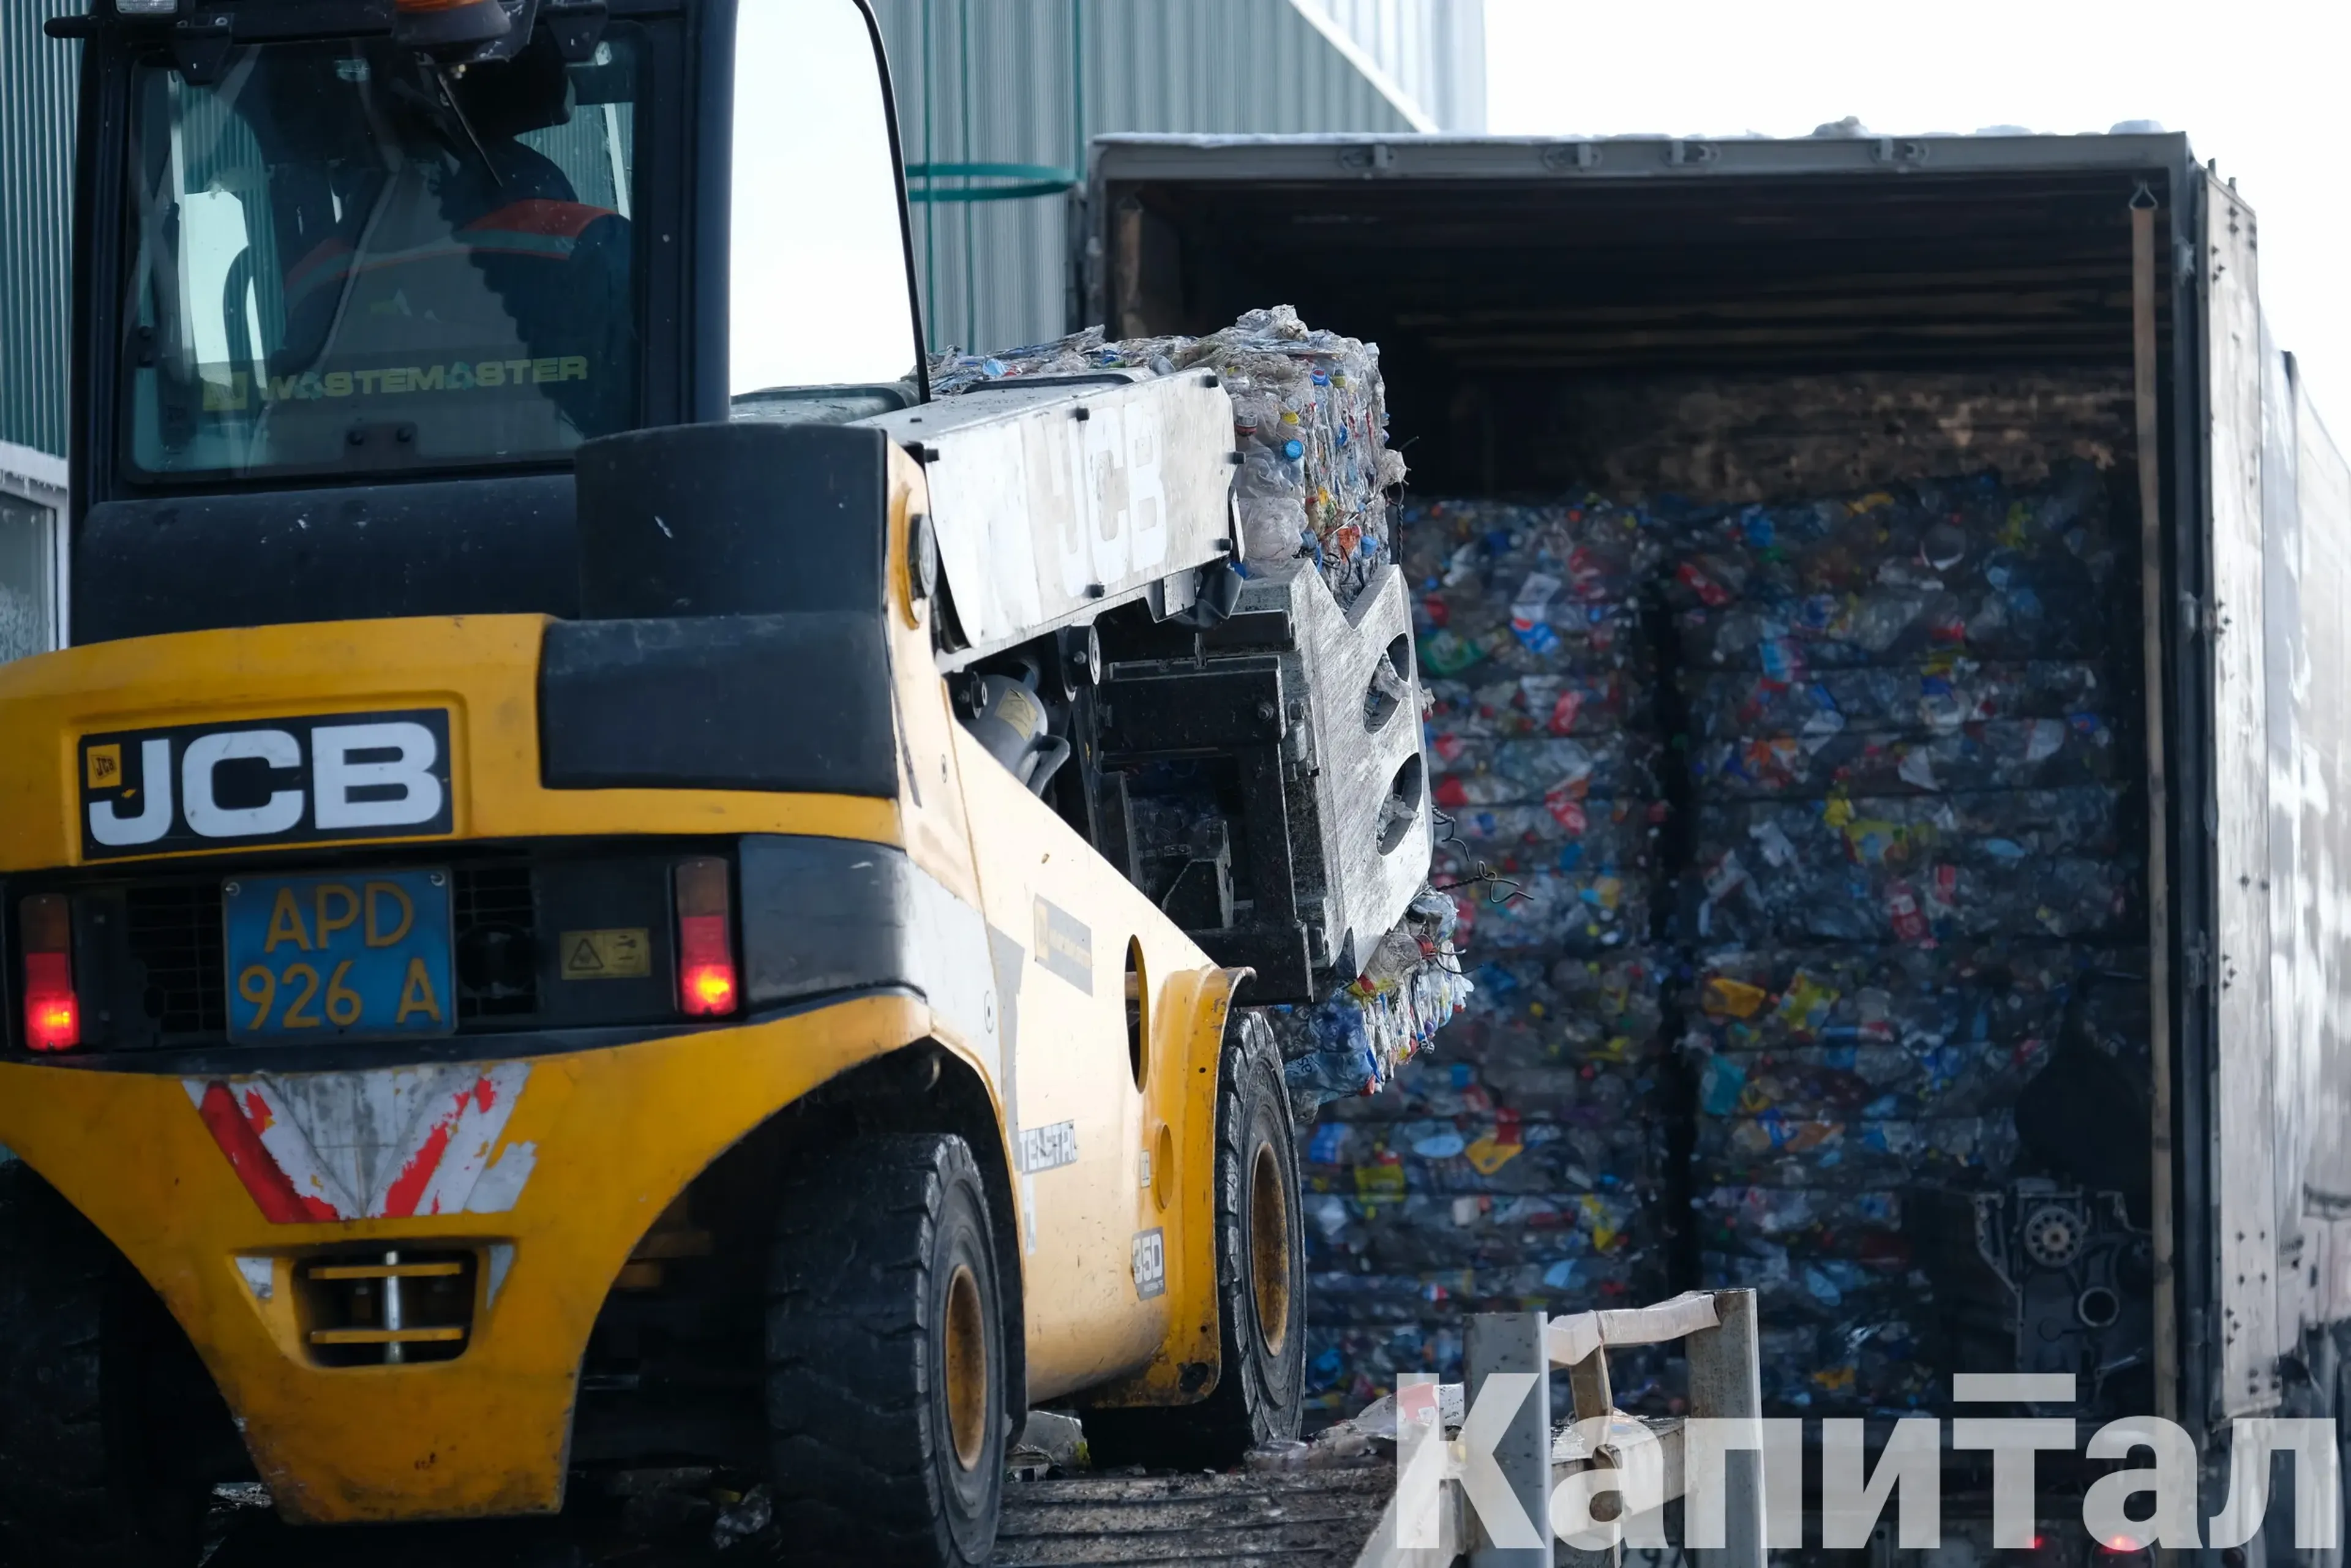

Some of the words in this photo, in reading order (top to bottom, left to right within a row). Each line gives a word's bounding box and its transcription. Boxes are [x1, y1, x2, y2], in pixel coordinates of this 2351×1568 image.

[262, 355, 588, 402] WASTEMASTER
[1057, 401, 1167, 598] JCB
[88, 721, 443, 846] JCB
[96, 757, 114, 776] JCB
[264, 882, 414, 954] APD
[238, 960, 362, 1031] 926
[396, 957, 442, 1025] A
